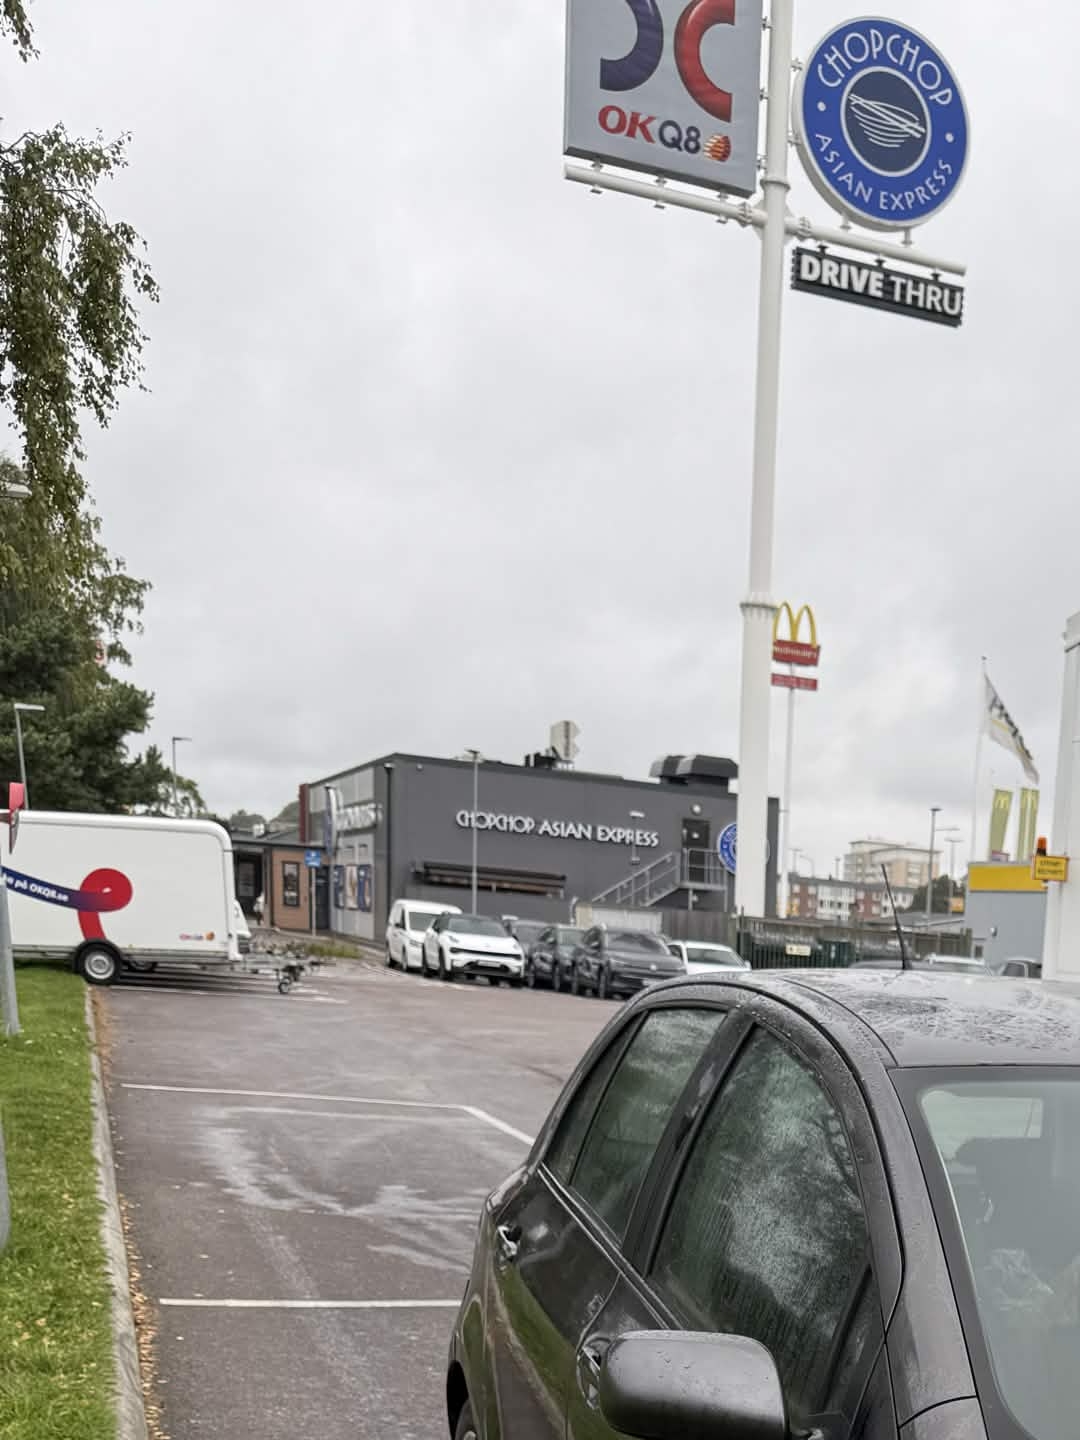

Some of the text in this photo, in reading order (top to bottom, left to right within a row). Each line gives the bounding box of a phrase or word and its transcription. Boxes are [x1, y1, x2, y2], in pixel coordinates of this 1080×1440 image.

[817, 28, 953, 108] CHOPCHOP
[815, 132, 953, 213] ASIAN EXPRESS
[799, 251, 962, 316] DRIVE THRU
[456, 810, 660, 848] CHOPCHOP ASIAN EXPRESS
